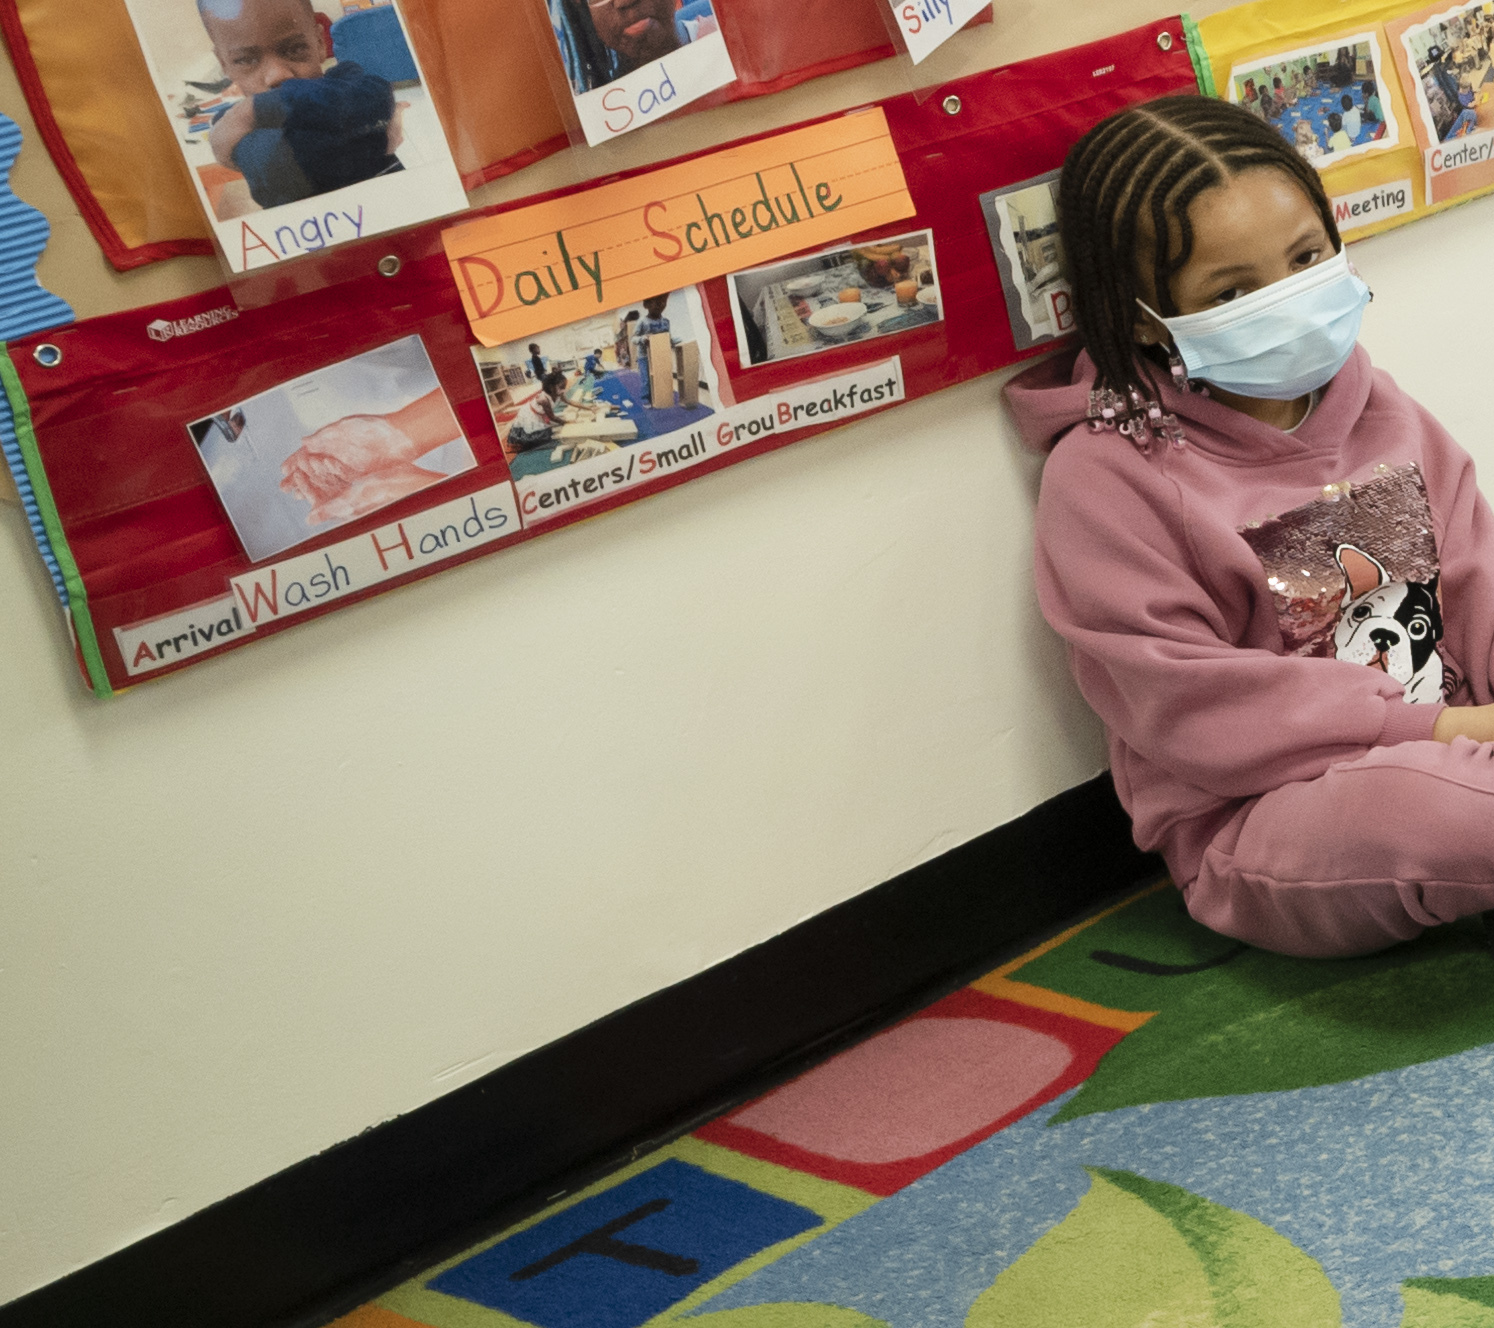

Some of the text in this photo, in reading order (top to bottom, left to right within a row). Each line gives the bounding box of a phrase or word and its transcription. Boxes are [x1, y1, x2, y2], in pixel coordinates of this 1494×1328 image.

[602, 63, 676, 133] Sad
[240, 203, 365, 272] Angry
[1334, 187, 1405, 221] Meeting
[456, 162, 844, 319] Daily Schedule
[171, 304, 232, 328] LEARNING
[174, 310, 239, 338] RESOURCES
[776, 376, 897, 428] Breakfast
[522, 412, 776, 515] Centers/Small Grou
[233, 497, 508, 623] Wash Hands
[133, 607, 243, 668] Arrival
[509, 1197, 698, 1281] T
